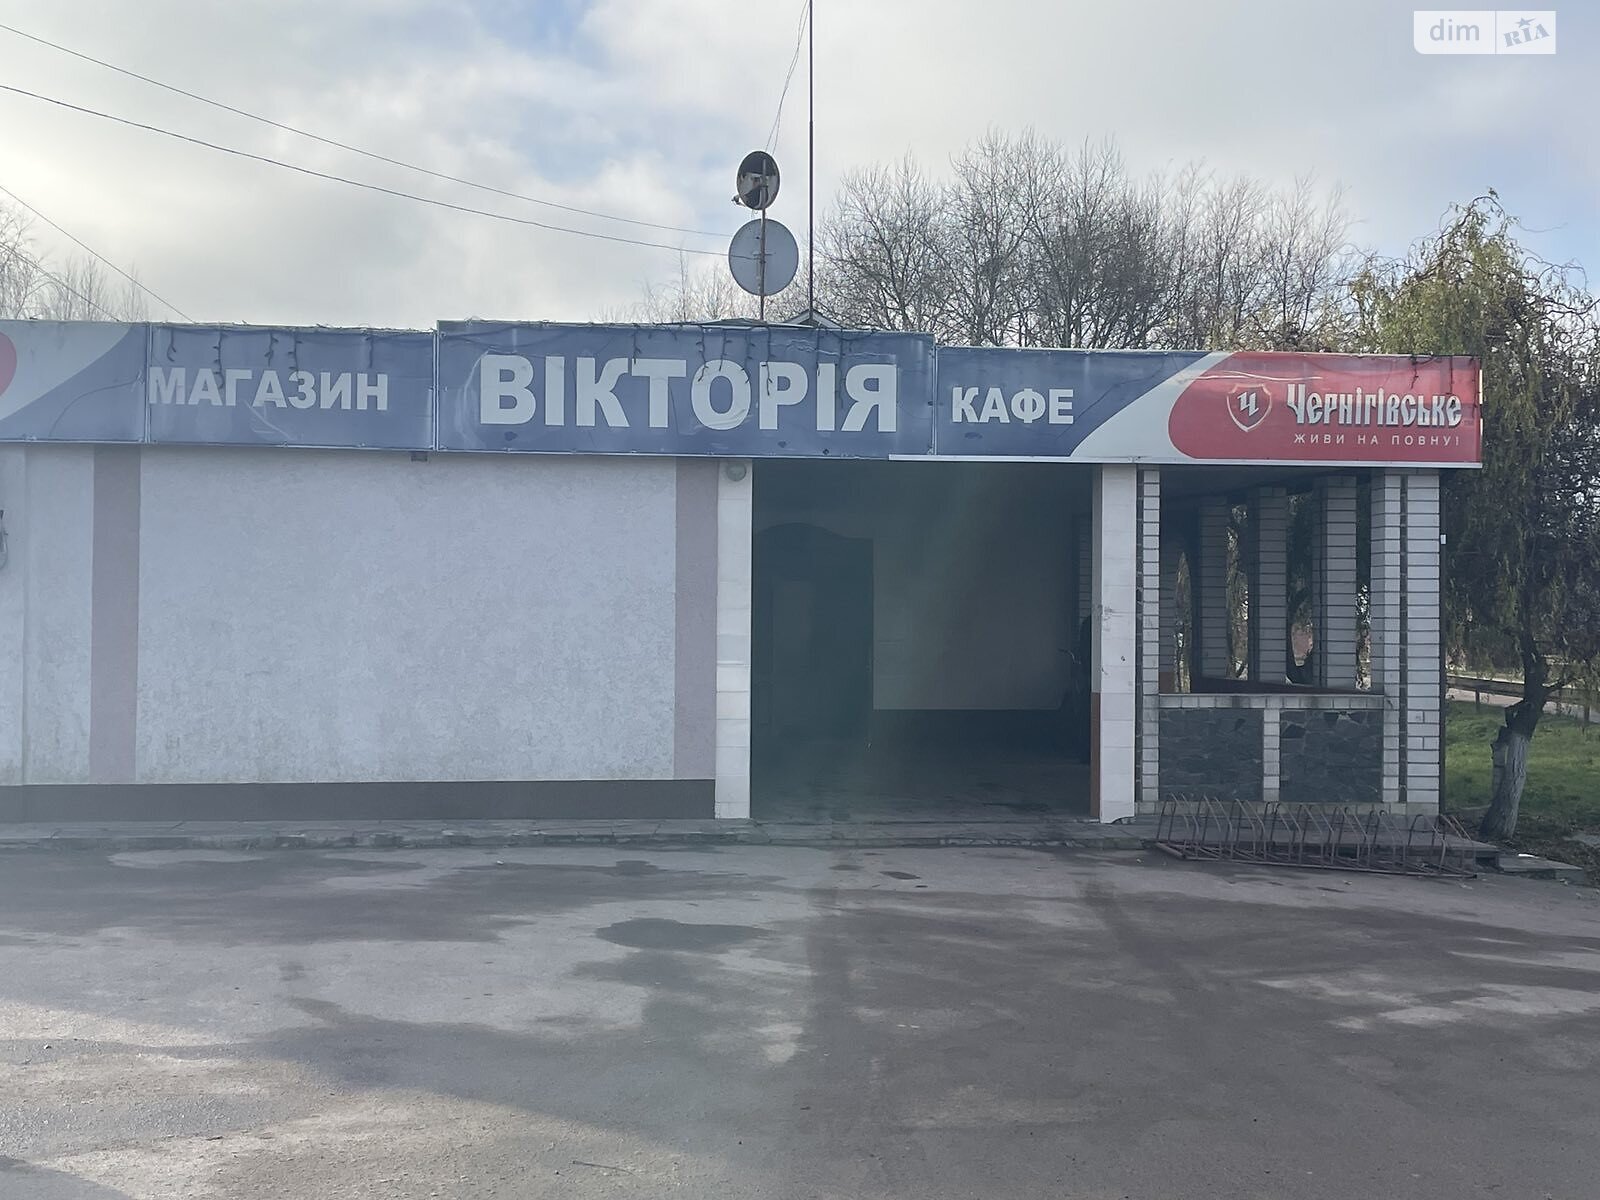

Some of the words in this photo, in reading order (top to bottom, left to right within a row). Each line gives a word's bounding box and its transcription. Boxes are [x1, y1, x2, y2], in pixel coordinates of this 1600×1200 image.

[148, 367, 388, 411] МАГАЗИН
[480, 354, 898, 432] ВІКТОРІЯ
[952, 386, 1074, 425] КАФЕ
[1294, 434, 1345, 444] ЖИВИ
[1357, 434, 1379, 445] НА
